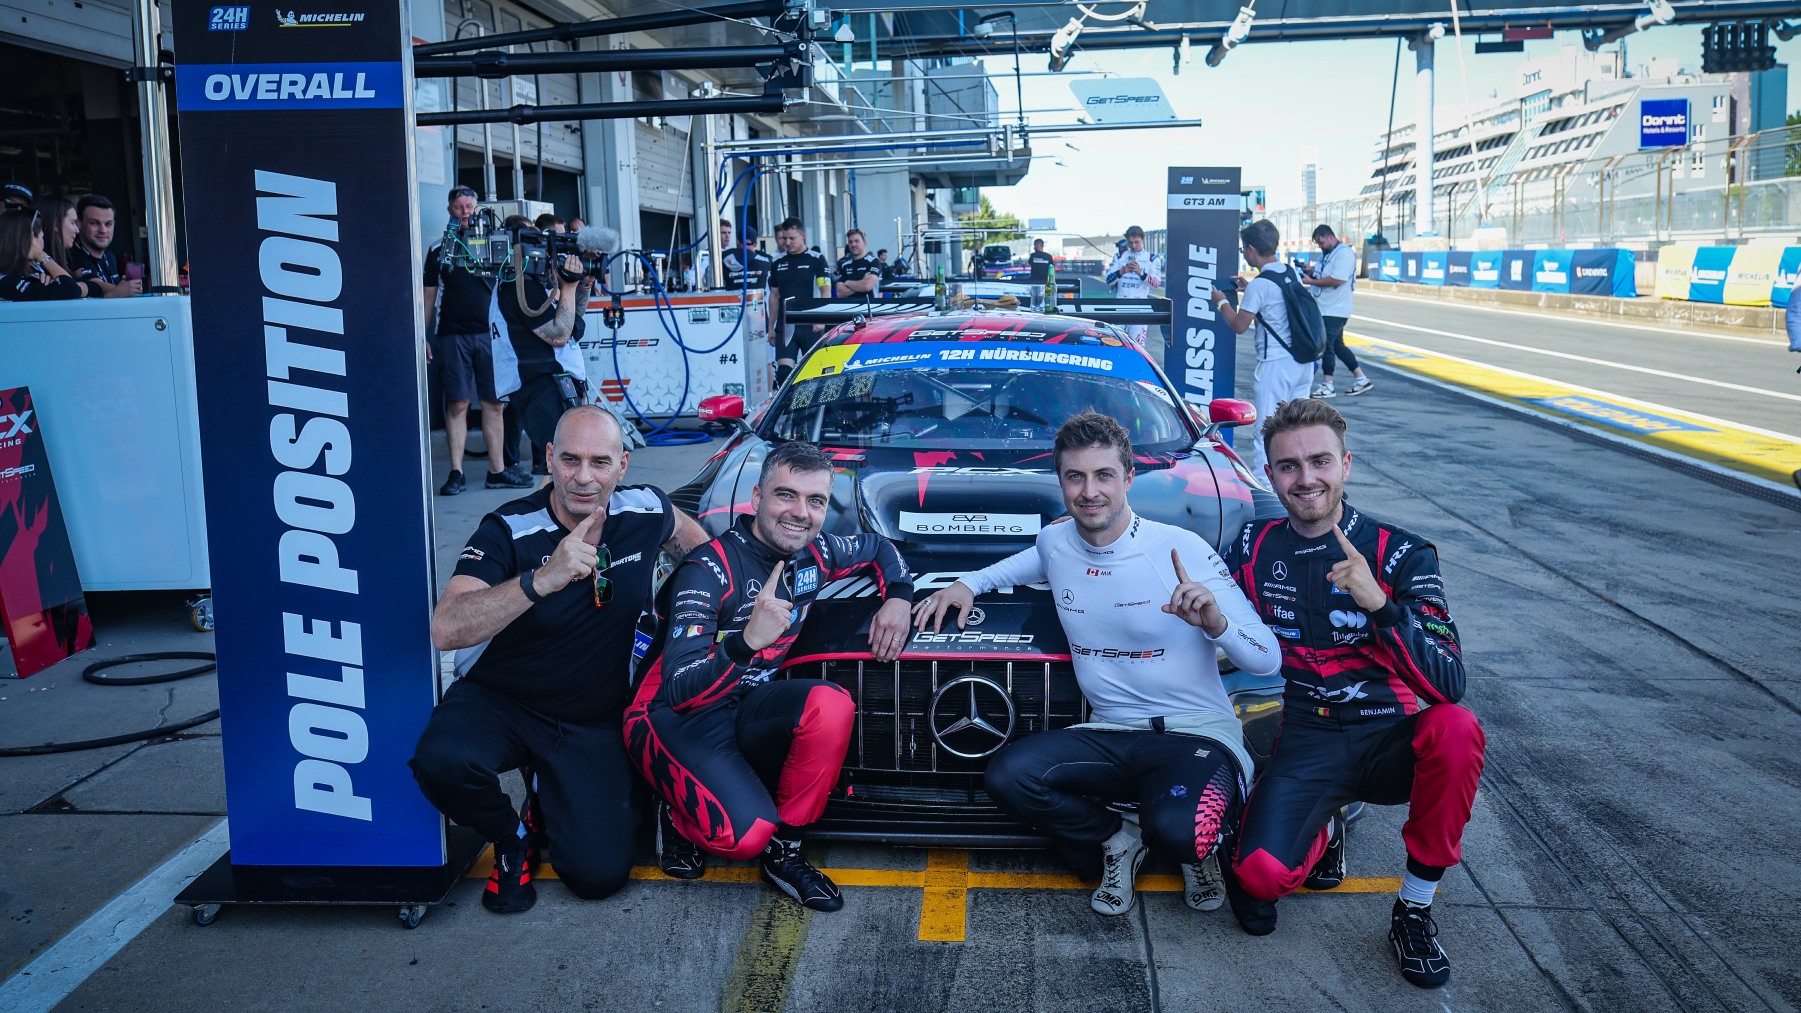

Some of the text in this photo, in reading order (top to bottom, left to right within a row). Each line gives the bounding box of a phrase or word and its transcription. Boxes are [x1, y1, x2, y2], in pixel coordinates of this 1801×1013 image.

[212, 8, 248, 23] 24H
[299, 13, 365, 22] MICHELIN
[211, 22, 246, 30] SERIES
[204, 73, 376, 101] OVERALL
[1183, 198, 1226, 206] GT3 AM
[1187, 243, 1218, 321] POLE
[719, 353, 738, 365] #4
[865, 347, 1114, 371] MICHELIN 12H NÜRBURGRING
[254, 169, 374, 822] POLE POSITION
[916, 524, 1024, 534] BOMBERG
[1343, 511, 1359, 537] HRX
[1242, 523, 1254, 557] HRX
[1384, 540, 1413, 575] HRX
[701, 556, 729, 586] HRX
[797, 568, 817, 587] 24H
[797, 582, 817, 593] SERIES
[1274, 583, 1297, 593] AMG
[1360, 706, 1396, 716] BENJAMIN
